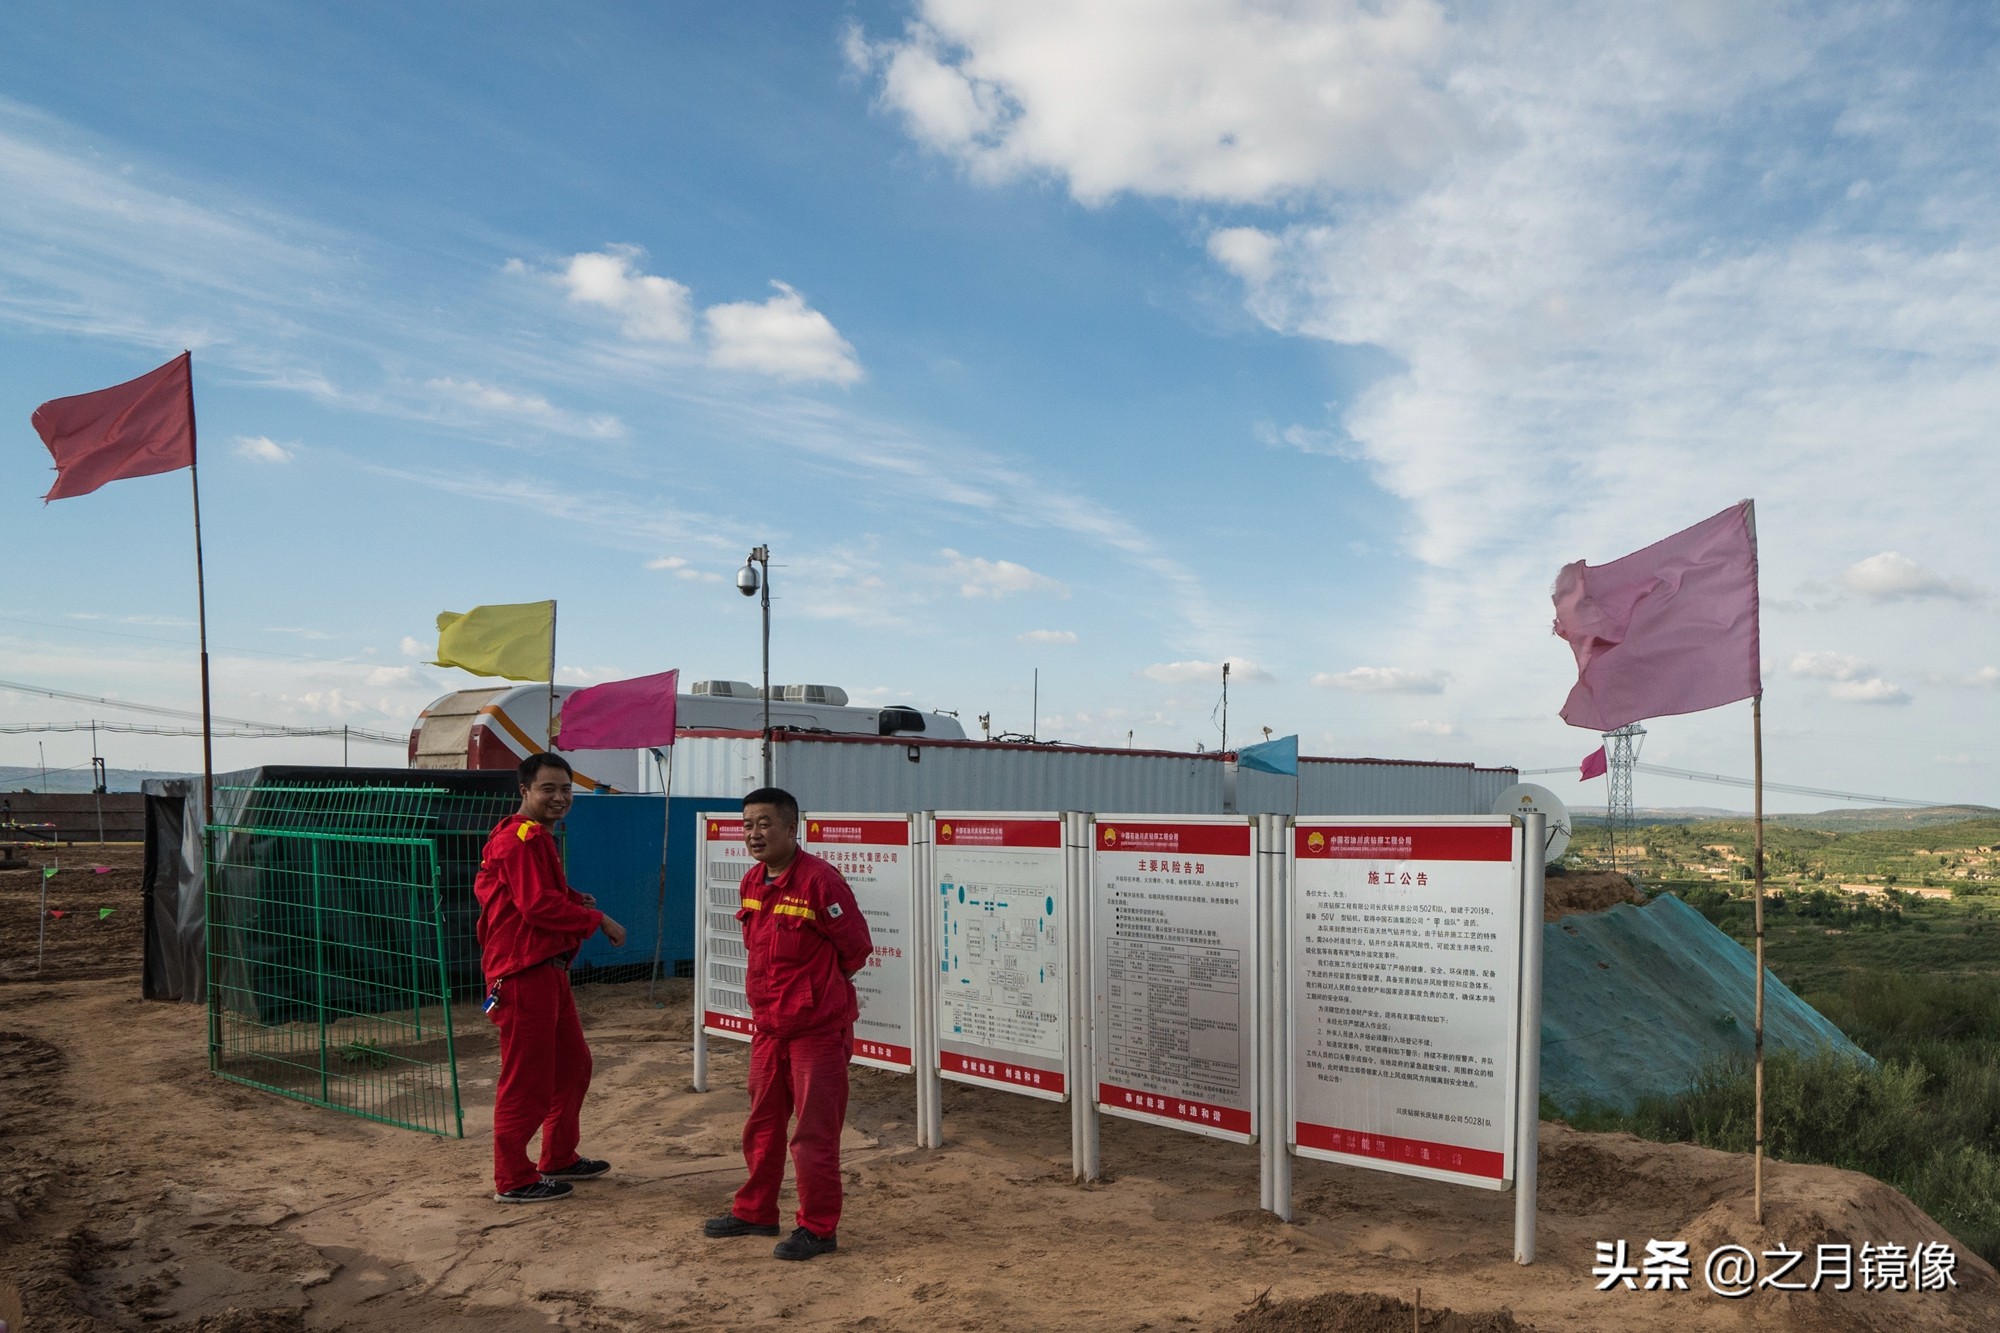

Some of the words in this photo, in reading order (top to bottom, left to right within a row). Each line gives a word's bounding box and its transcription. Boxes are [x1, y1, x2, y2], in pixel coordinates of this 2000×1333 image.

[1330, 836, 1412, 845] 中国石油川庆钻探工程公司
[815, 850, 898, 863] 中国石油天然气集团公司
[1138, 859, 1205, 874] 主要风险告知
[1368, 871, 1428, 886] 施工公告
[1125, 1093, 1165, 1110] 奉献能源
[1178, 1104, 1222, 1122] 创造和谐
